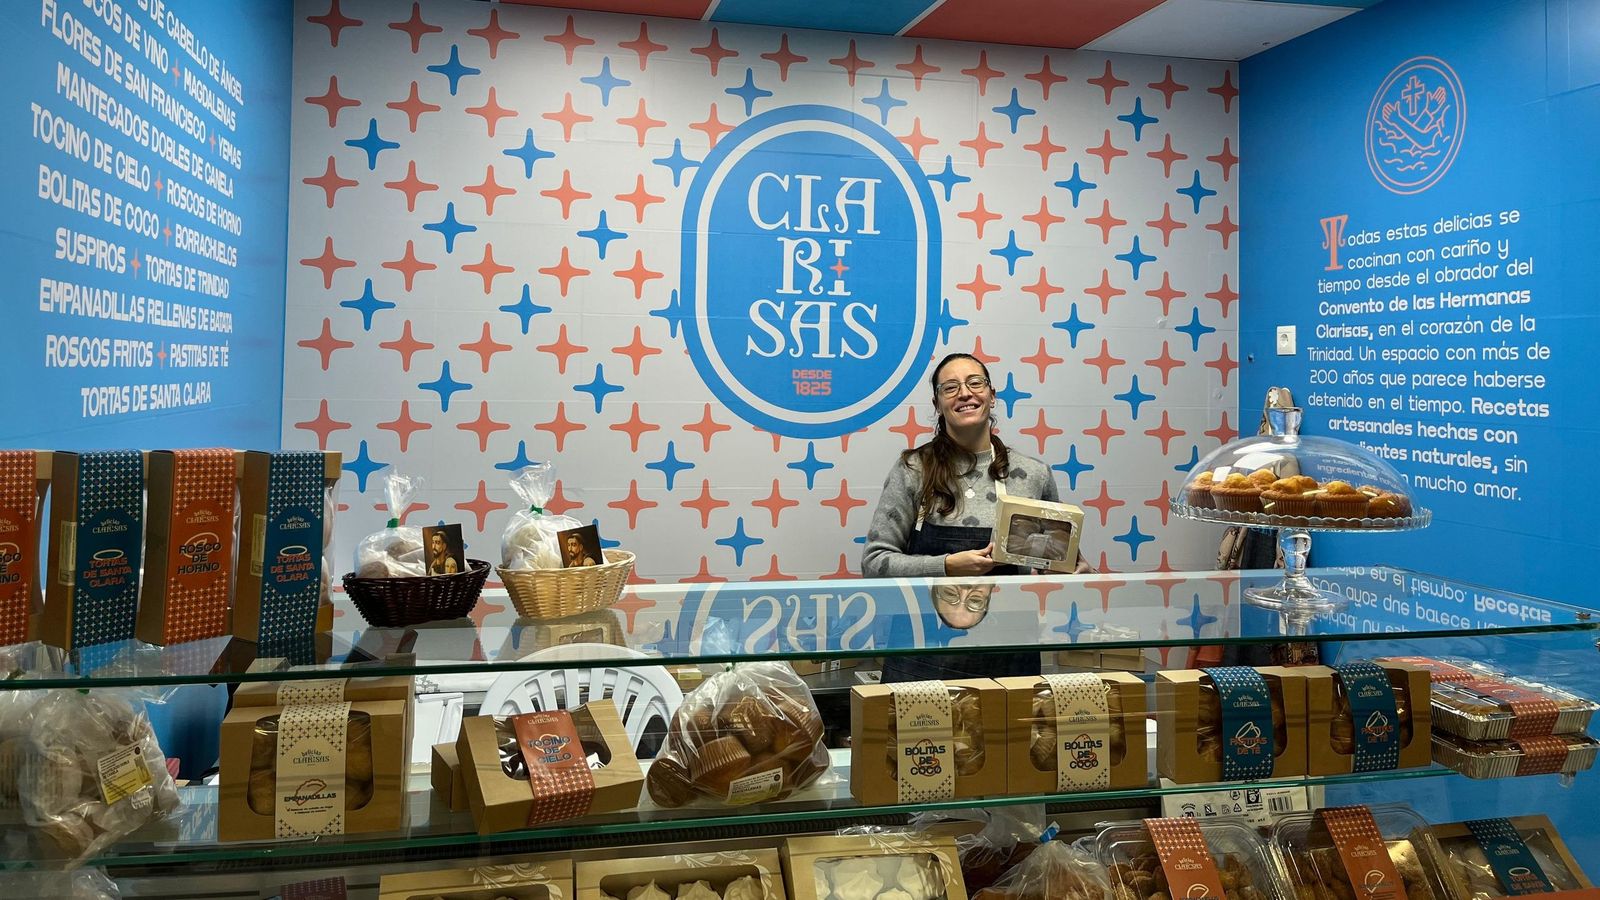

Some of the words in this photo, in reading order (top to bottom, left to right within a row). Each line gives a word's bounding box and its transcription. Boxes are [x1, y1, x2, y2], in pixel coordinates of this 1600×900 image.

[125, 13, 141, 52] DE
[144, 29, 169, 74] VINO
[150, 0, 165, 29] DE
[167, 11, 208, 70] CABELLO
[209, 53, 220, 83] DE
[220, 59, 244, 106] ÁNGEL
[42, 0, 102, 67] FLORES
[104, 44, 123, 84] DE
[125, 62, 149, 104] SAN
[152, 82, 206, 144] FRANCISCO
[184, 67, 236, 132] MAGDALENAS
[57, 61, 149, 147] MANTECADOS
[152, 125, 190, 172] DOBLES
[192, 153, 203, 180] DE
[205, 162, 234, 199] CANELA
[31, 102, 91, 163] TOCINO
[94, 137, 113, 174] DE
[116, 151, 150, 192] CIELO
[218, 134, 241, 170] YEMAS
[38, 163, 101, 218] BOLITAS
[104, 192, 122, 227] DE
[125, 202, 159, 240] COCO
[167, 178, 205, 219] ROSCOS
[206, 199, 217, 225] DE
[217, 205, 242, 236] HORNO
[747, 172, 882, 235] CLA
[1386, 221, 1428, 241] estas
[1433, 212, 1493, 236] delicias
[1499, 209, 1521, 226] se
[55, 227, 126, 274] SUSPIROS
[175, 223, 237, 268] BORRACHUELOS
[1347, 252, 1401, 270] cocinan
[1406, 248, 1435, 264] con
[1441, 239, 1491, 259] cariño
[1497, 239, 1509, 260] y
[145, 254, 183, 288] TORTAS
[184, 266, 196, 292] DE
[775, 236, 852, 296] RI
[1317, 276, 1362, 295] tiempo
[1366, 271, 1411, 290] desde
[1416, 268, 1429, 285] el
[1434, 262, 1499, 284] obrador
[1506, 257, 1533, 278] del
[40, 278, 145, 323] EMPANADILLAS
[147, 298, 197, 329] RELLENAS
[198, 307, 209, 331] DE
[210, 310, 233, 334] BATATA
[1318, 298, 1385, 317] Convento
[1388, 296, 1408, 312] de
[1412, 294, 1436, 311] las
[1440, 289, 1531, 308] Hermanas
[746, 299, 879, 360] SAS
[1316, 323, 1374, 341] Clarisas,
[1378, 323, 1396, 337] en
[1401, 320, 1414, 336] el
[1419, 314, 1484, 336] corazón
[1490, 315, 1513, 333] de
[1520, 314, 1536, 333] la
[45, 334, 110, 368] ROSCOS
[113, 339, 153, 368] FRITOS
[170, 343, 208, 368] PASTITAS
[208, 344, 219, 367] DE
[220, 340, 229, 367] TÉ
[1307, 346, 1355, 362] Trinidad.
[1359, 346, 1377, 362] Un
[1381, 344, 1440, 364] espacio
[1445, 348, 1476, 361] con
[1482, 341, 1519, 361] más
[1526, 342, 1551, 361] de
[792, 369, 832, 380] DESDE
[1309, 369, 1339, 385] 200
[1343, 369, 1374, 386] años
[1379, 373, 1407, 390] que
[1412, 373, 1468, 390] parece
[1474, 371, 1546, 389] haberse
[81, 386, 130, 418] TORTAS
[132, 384, 149, 412] DE
[150, 383, 181, 410] SANTA
[184, 381, 212, 407] CLARA
[792, 381, 832, 396] 1825
[1308, 392, 1363, 409] detenido
[1368, 396, 1385, 410] en
[1390, 395, 1403, 411] el
[1408, 395, 1465, 416] tiempo.
[1471, 397, 1550, 418] Recetas
[1328, 416, 1413, 437] artesanales
[1417, 421, 1478, 441] hechas
[1483, 428, 1518, 445] con
[1412, 449, 1498, 474] naturales,
[1504, 454, 1528, 474] sin
[1415, 474, 1467, 494] mucho
[1473, 482, 1522, 501] amor.
[179, 542, 222, 555] ROSCO
[192, 553, 209, 564] DE
[277, 553, 311, 564] TORTAS
[83, 570, 97, 579] DE
[100, 566, 132, 577] SANTA
[177, 562, 221, 575] HORNO
[270, 565, 284, 574] DE
[286, 562, 315, 573] SANTA
[276, 572, 309, 583] CLARA
[90, 577, 125, 588] CLARA
[528, 736, 571, 748] TOCINO
[544, 747, 560, 755] DE
[905, 745, 946, 756] BOLITAS
[1064, 740, 1103, 751] BOLITAS
[1077, 750, 1091, 760] DE
[537, 752, 572, 764] CIELO
[910, 766, 942, 776] COCO
[919, 756, 933, 765] DE
[1069, 759, 1099, 769] COCO
[284, 792, 337, 802] EMPANADILLAS
